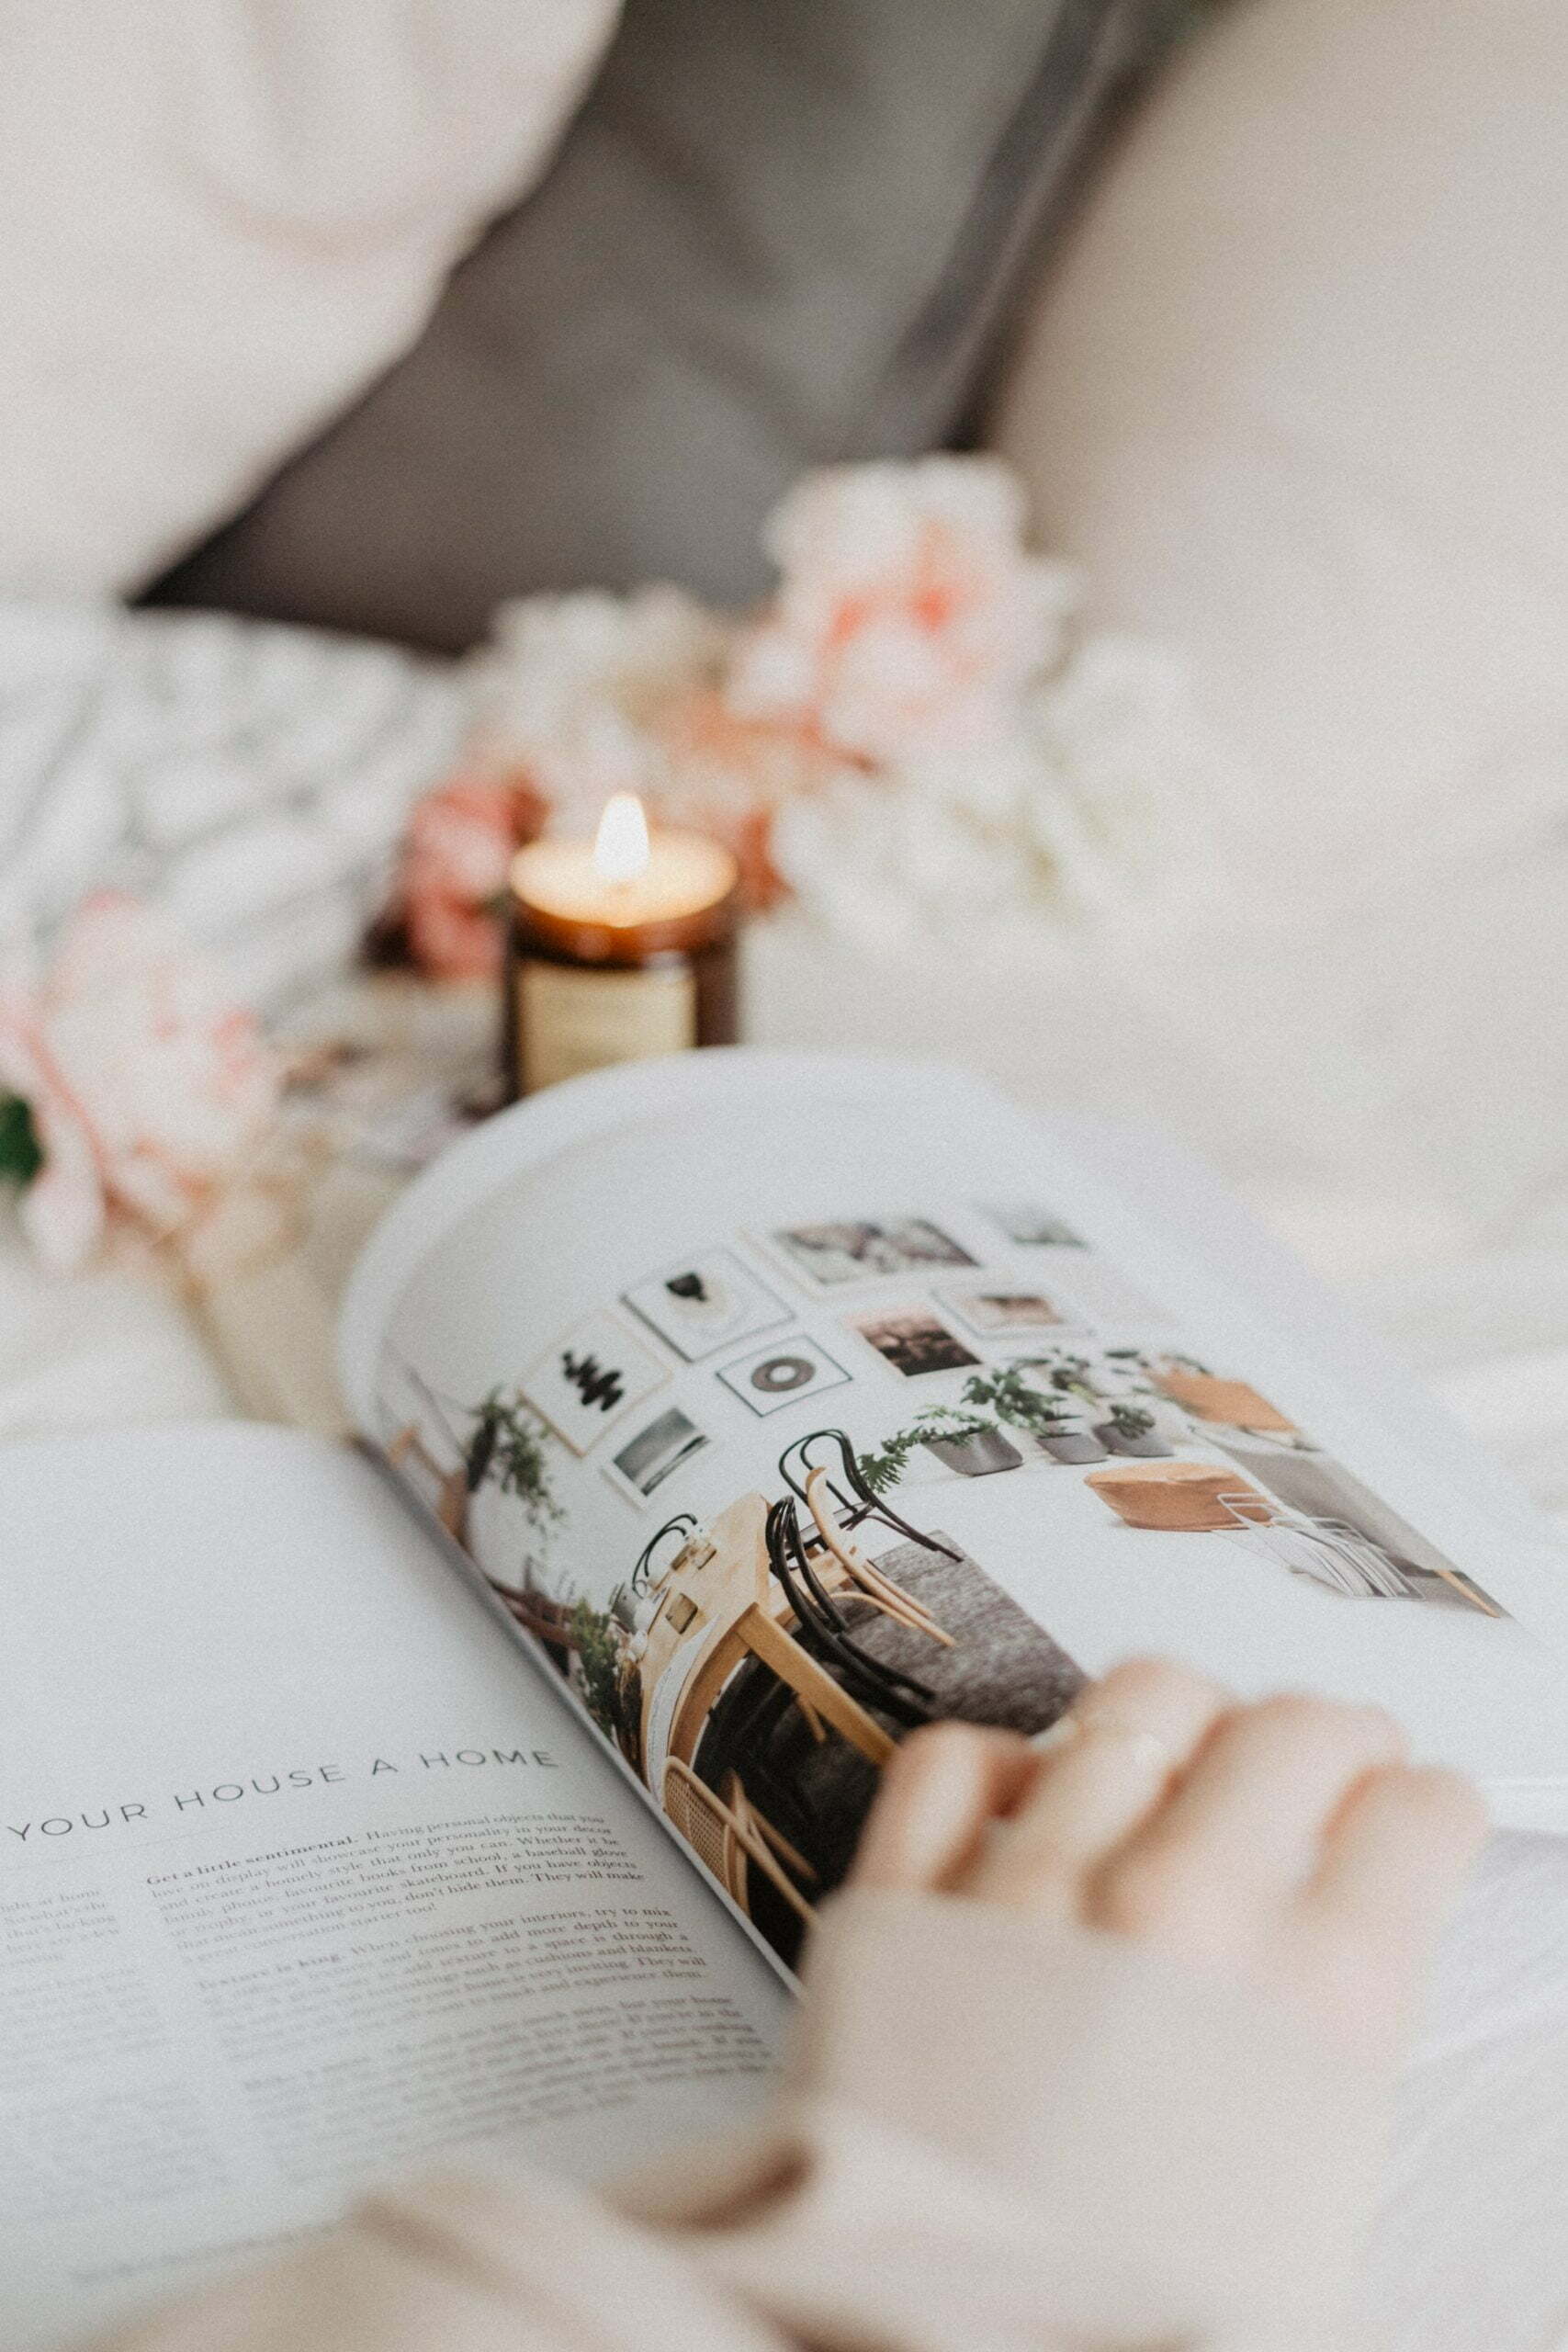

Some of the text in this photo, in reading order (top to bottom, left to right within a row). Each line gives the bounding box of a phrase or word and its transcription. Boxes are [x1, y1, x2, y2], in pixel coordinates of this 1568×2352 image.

[6, 1748, 560, 1843] YOUR HOUSE A HOME
[147, 1871, 177, 1885] Get
[197, 1858, 239, 1875] little
[245, 1835, 359, 1864] sentimental.
[367, 1826, 423, 1839] Having
[426, 1814, 491, 1833] personal
[493, 1812, 544, 1826] objects
[547, 1810, 576, 1821] that
[578, 1815, 604, 1826] you
[216, 1869, 271, 1884] display
[277, 1858, 305, 1873] will
[386, 1839, 421, 1855] your
[427, 1827, 511, 1847] personality
[536, 1825, 567, 1836] your
[408, 1847, 440, 1860] only
[446, 1844, 475, 1857] you
[517, 1834, 581, 1847] Whether
[411, 1860, 448, 1873] from
[525, 1845, 586, 1858] baseball
[592, 1846, 627, 1860] glove
[400, 1866, 490, 1889] skateboard.
[513, 1862, 541, 1874] you
[547, 1859, 581, 1869] have
[587, 1857, 637, 1871] objects
[447, 1881, 480, 1894] hide
[575, 1869, 604, 1880] will
[606, 1870, 646, 1881] make
[479, 1918, 515, 1933] your
[594, 1907, 617, 1919] try
[623, 1906, 637, 1916] to
